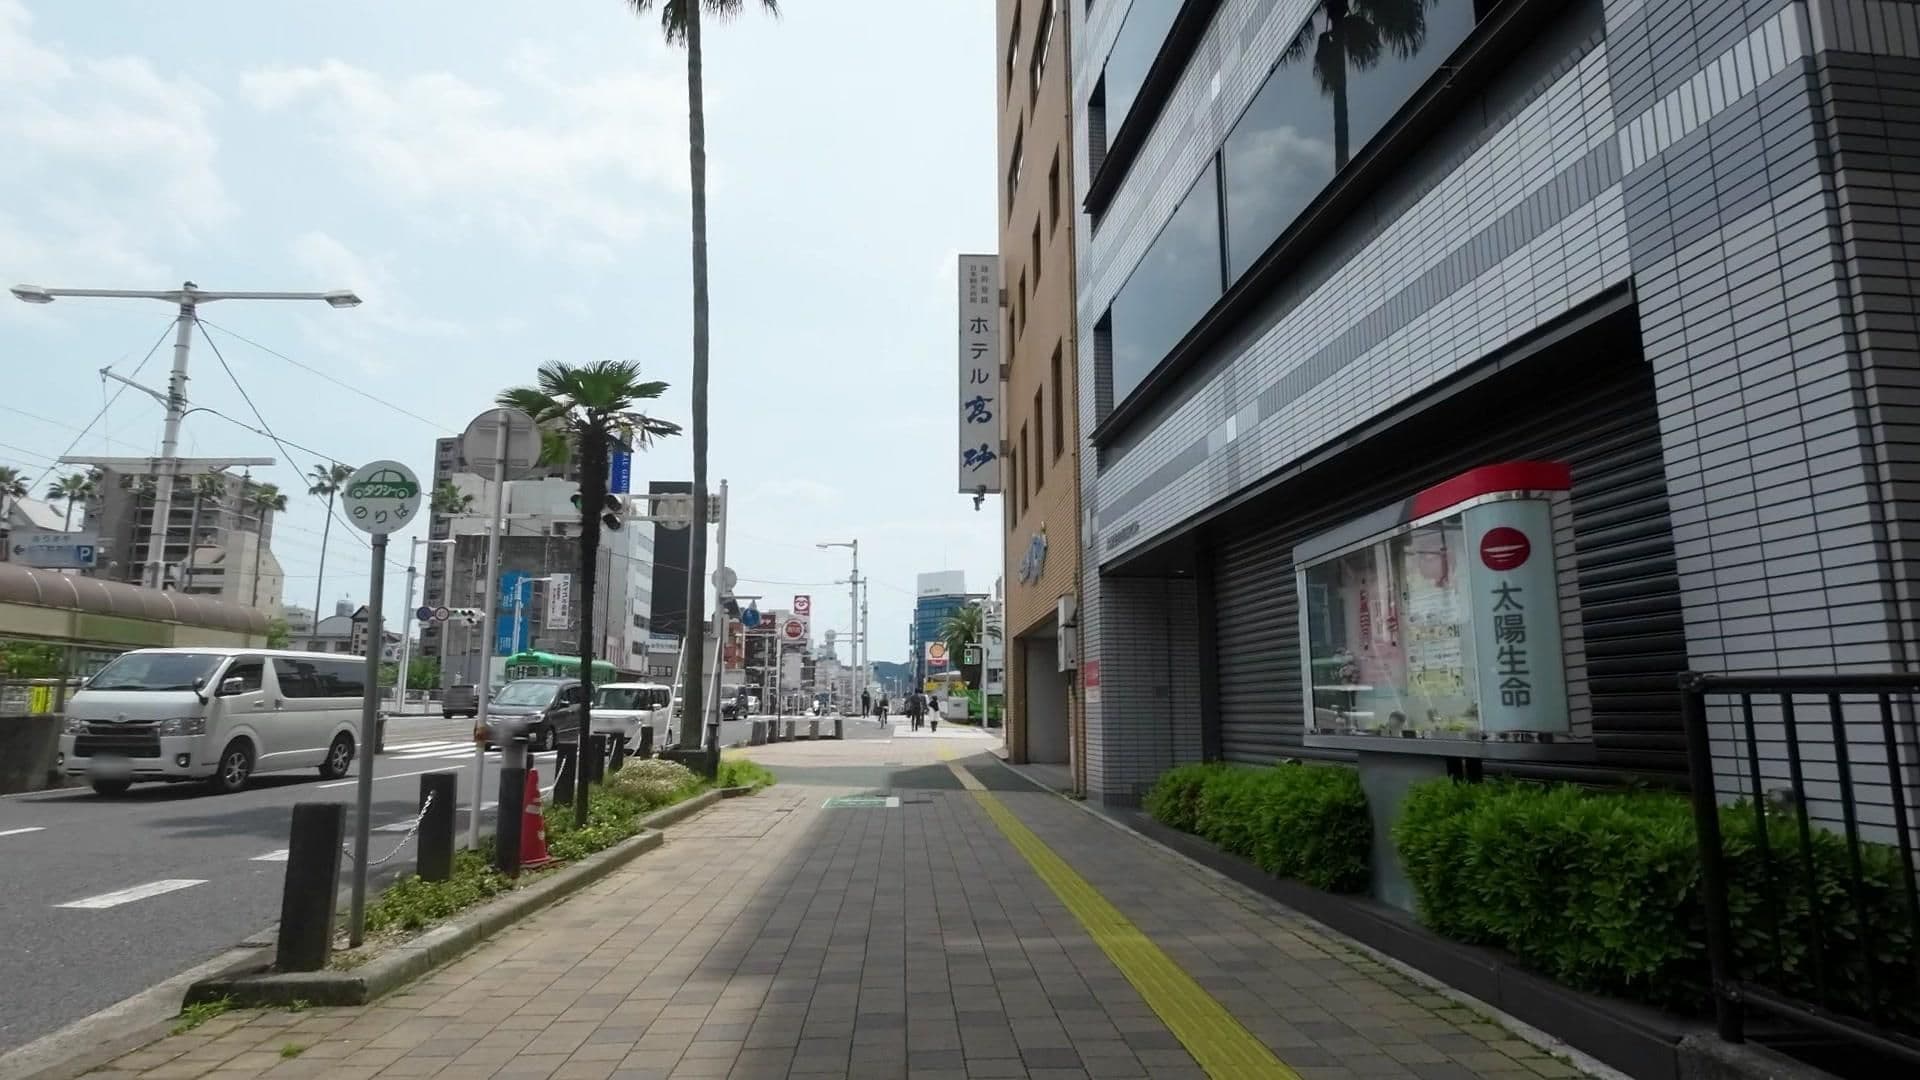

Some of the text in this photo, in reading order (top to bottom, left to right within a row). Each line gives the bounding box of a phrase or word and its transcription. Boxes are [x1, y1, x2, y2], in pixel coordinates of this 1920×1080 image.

[363, 484, 398, 497] タクシー
[353, 503, 410, 524] のりば
[1491, 580, 1532, 708] 太陽生命
